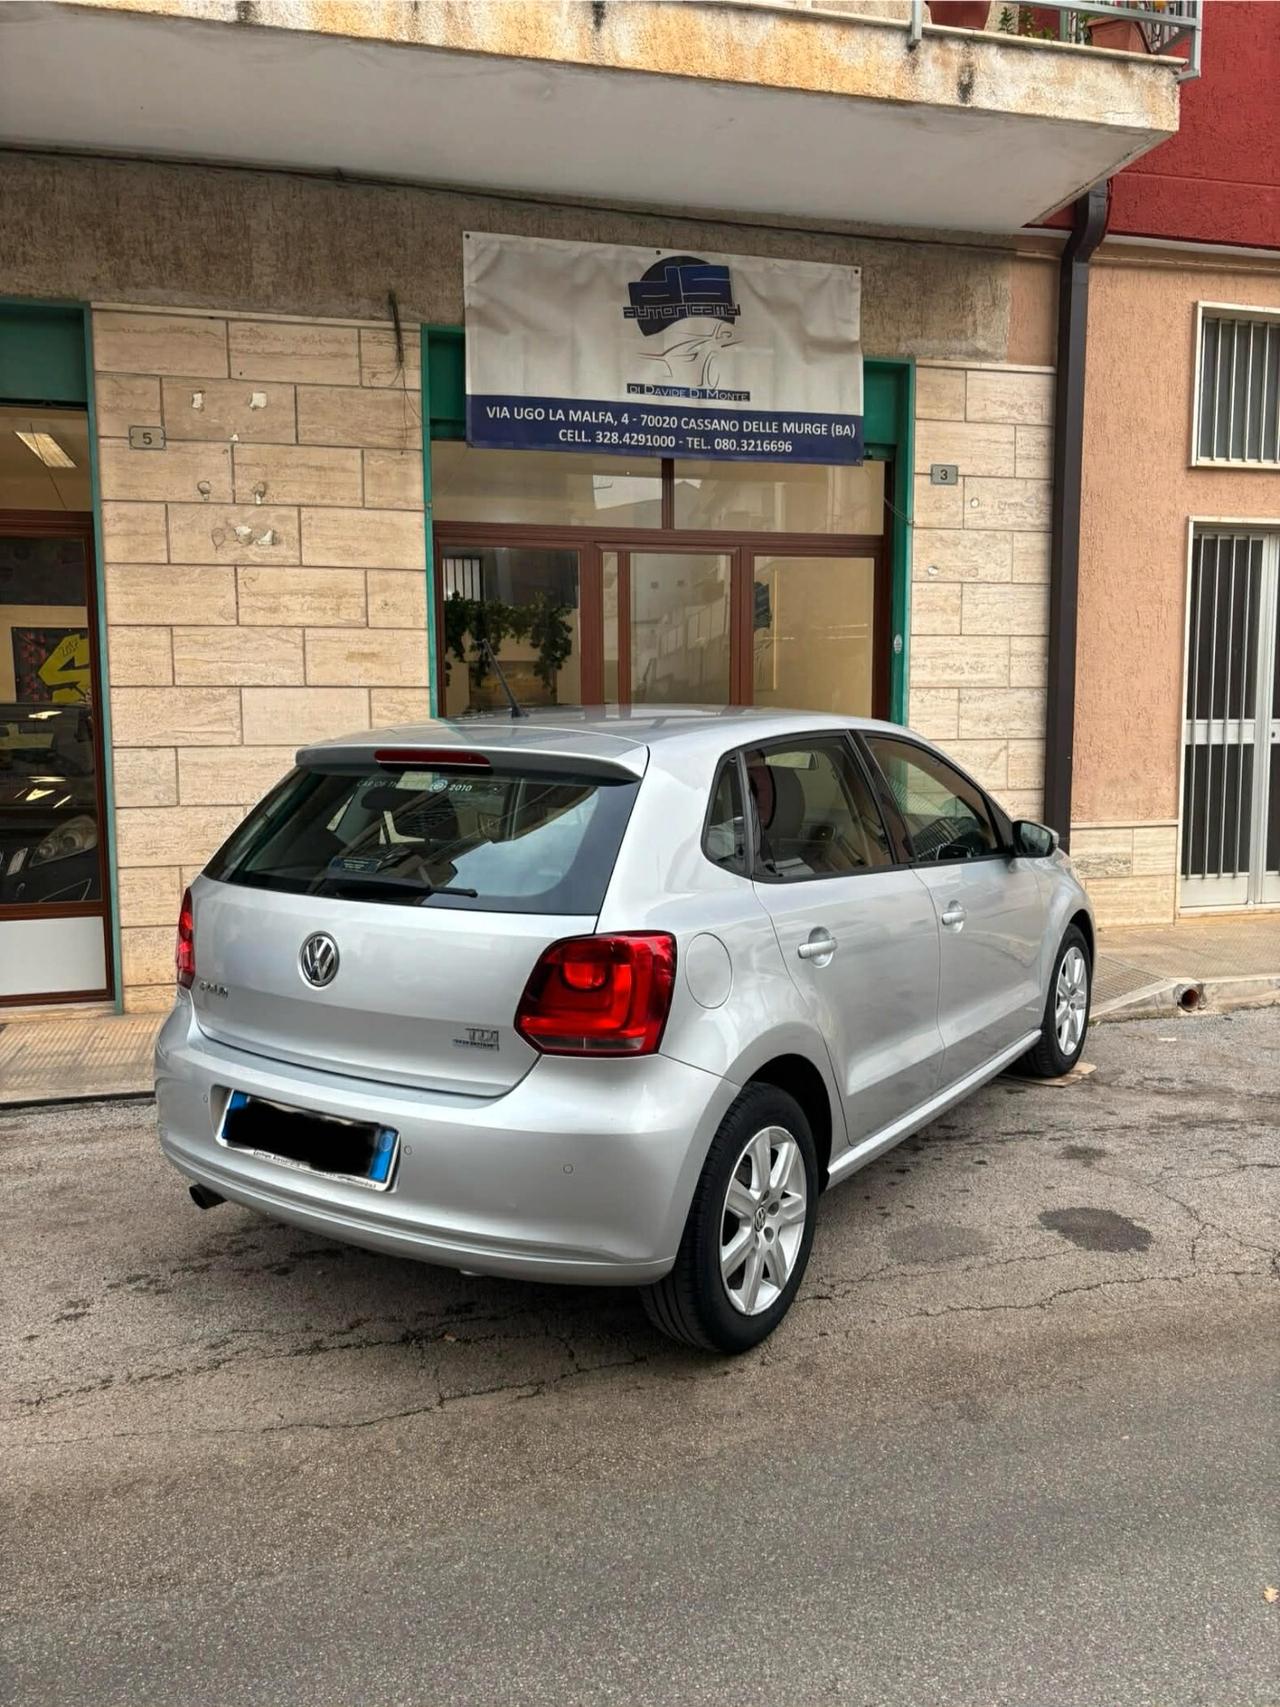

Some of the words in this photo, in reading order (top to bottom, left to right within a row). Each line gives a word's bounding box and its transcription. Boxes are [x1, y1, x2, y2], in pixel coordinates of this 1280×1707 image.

[487, 406, 510, 419] VIA
[514, 407, 545, 421] UGO
[549, 409, 565, 421] LA
[569, 410, 618, 426] MALFA,
[621, 413, 629, 425] 4
[640, 414, 678, 429] 70020
[681, 417, 739, 432] CASSANO
[743, 421, 779, 433] DELLE
[783, 422, 828, 436] MURGE
[831, 422, 856, 438] (BA)
[142, 432, 153, 445] 5
[558, 428, 592, 443] CELL.
[595, 431, 676, 448] 328.4291000
[686, 437, 711, 450] TEL.
[714, 438, 793, 453] 080.3216696
[940, 469, 948, 481] 3
[449, 783, 473, 793] 2010
